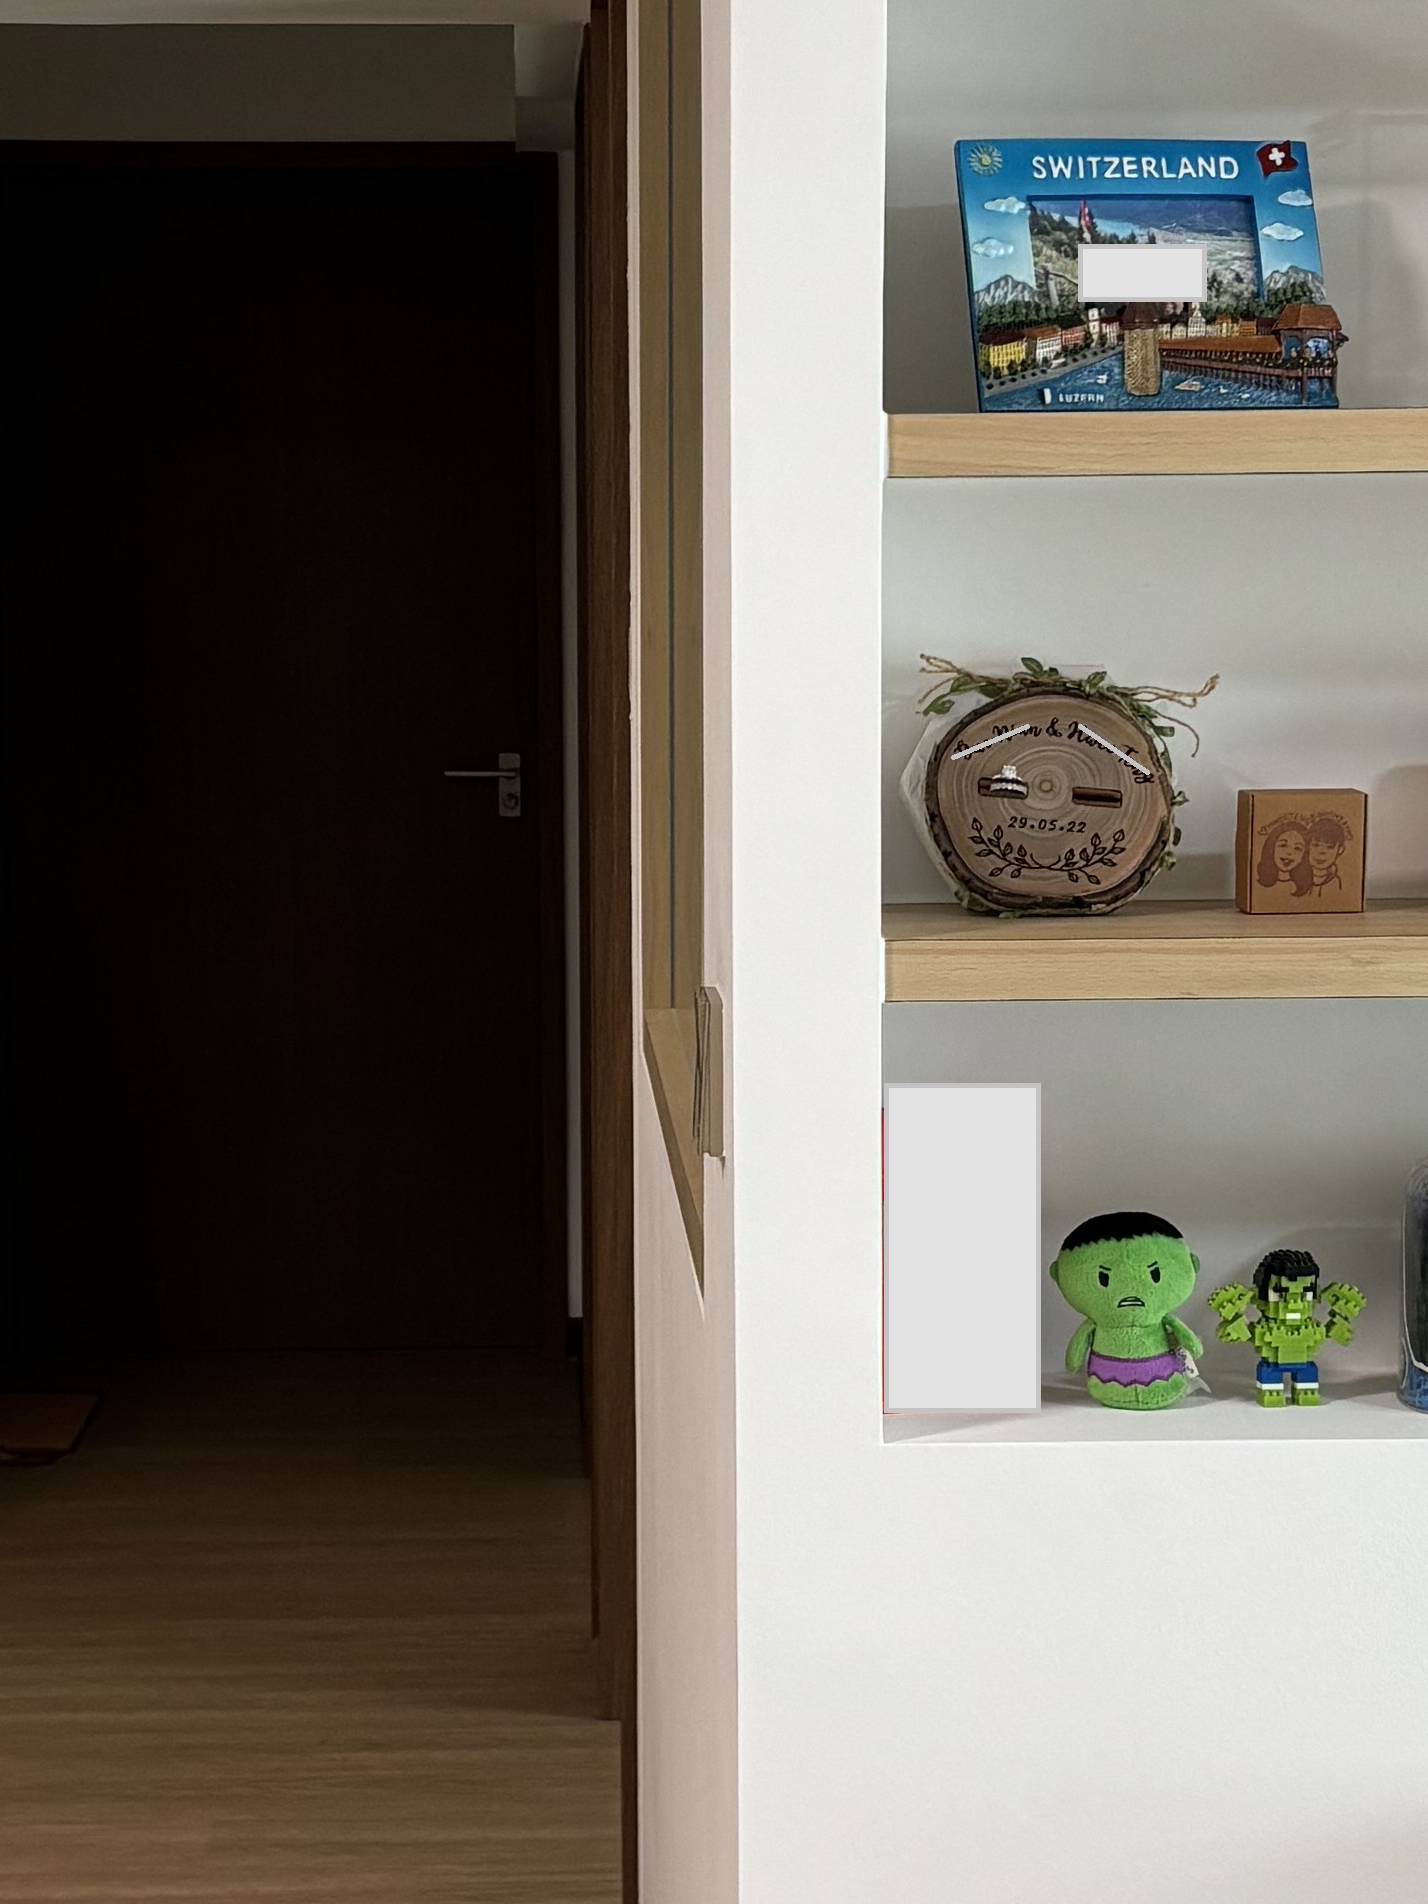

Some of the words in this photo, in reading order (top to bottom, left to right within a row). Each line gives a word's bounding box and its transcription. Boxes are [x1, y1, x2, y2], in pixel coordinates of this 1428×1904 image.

[1032, 154, 1240, 180] SWITZERLAND
[1058, 393, 1104, 403] LUZERN
[1008, 816, 1087, 834] 29.05.22
